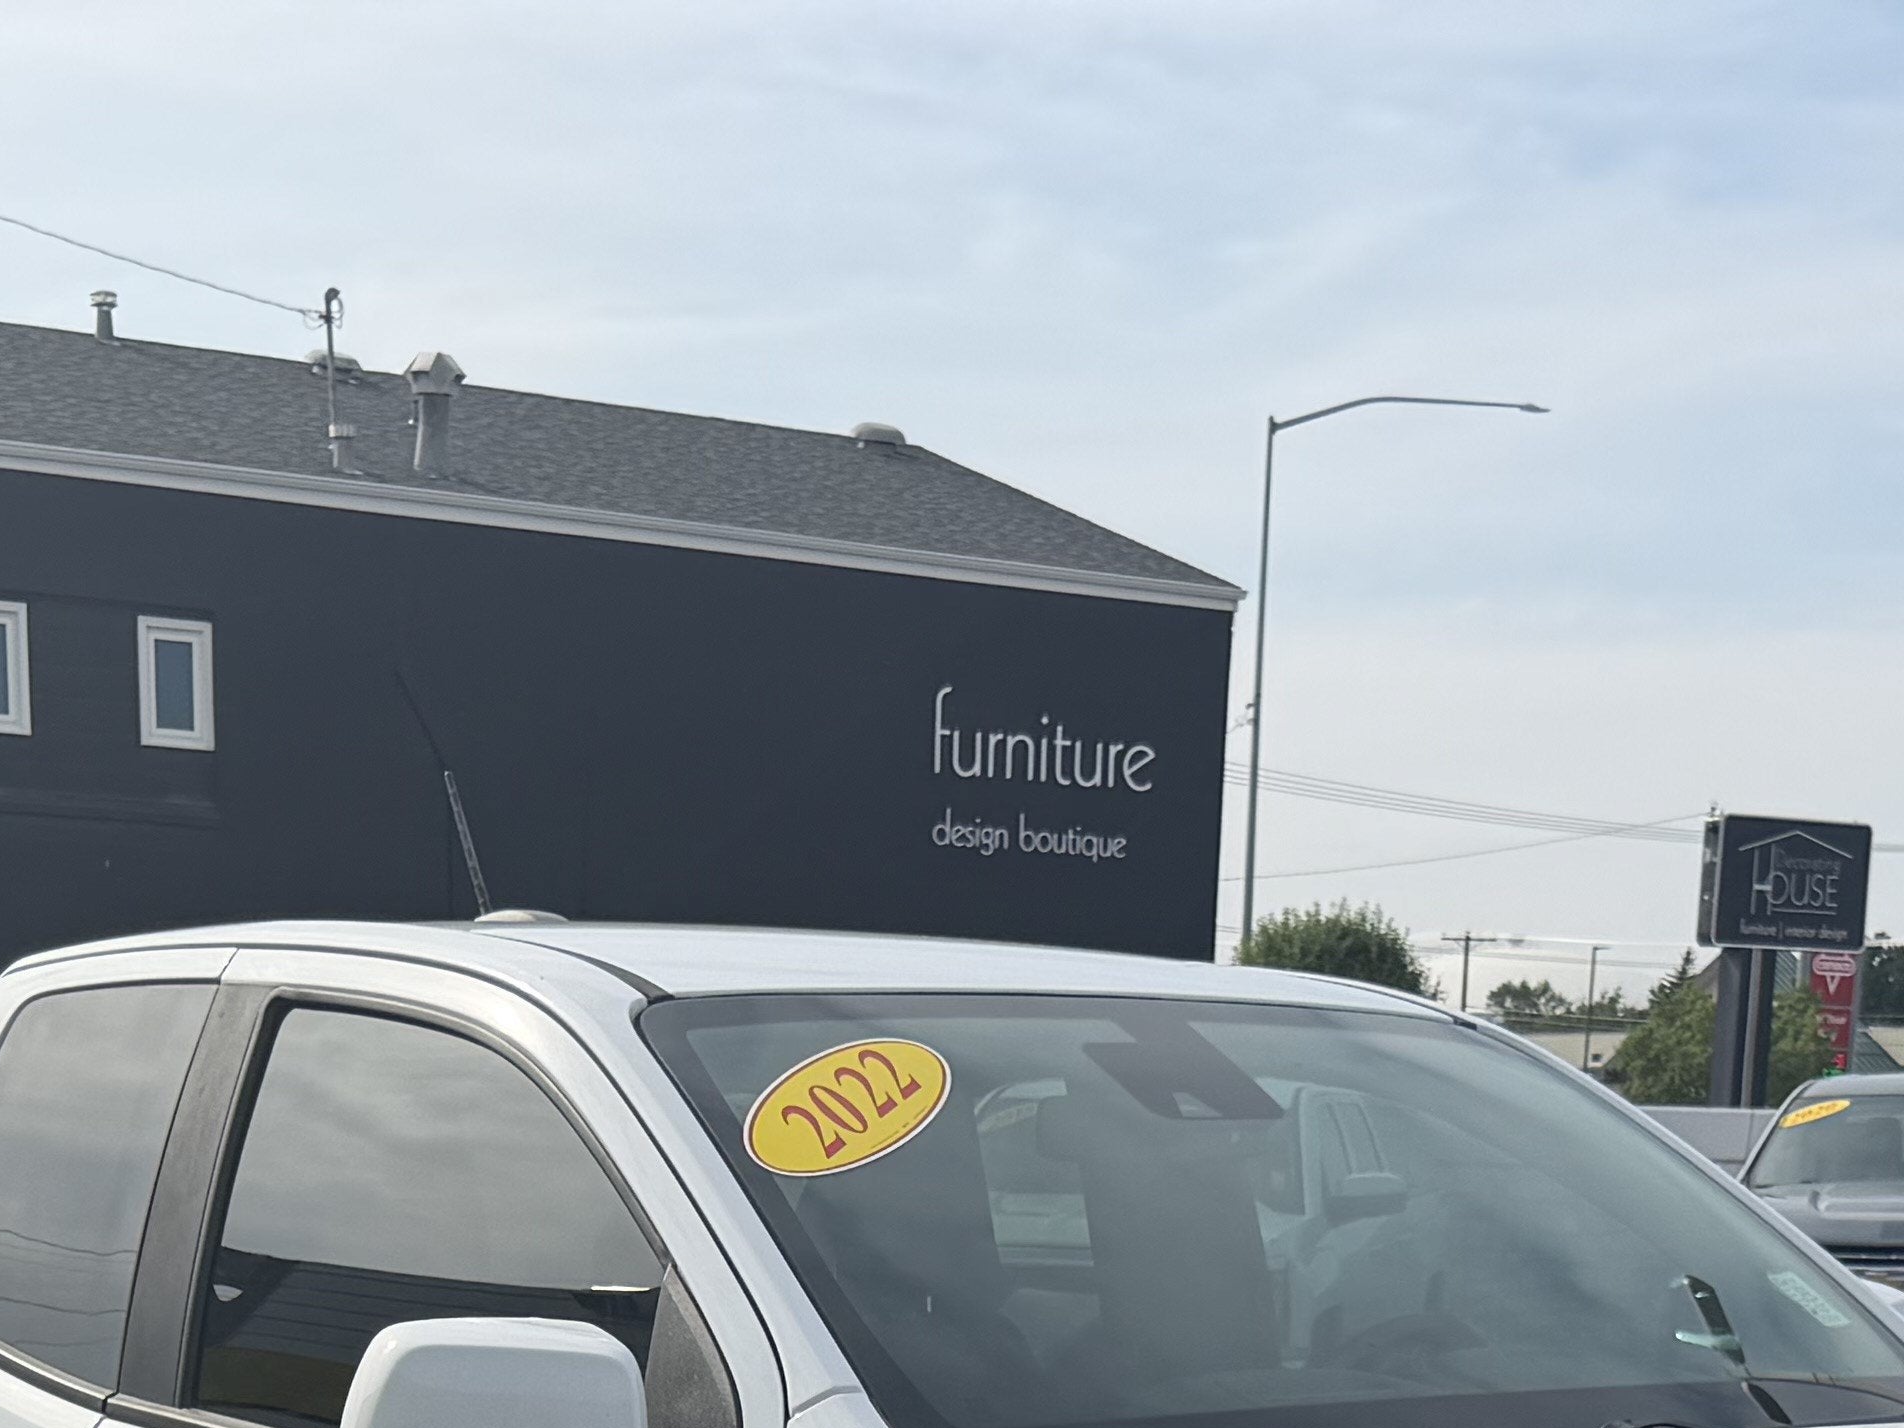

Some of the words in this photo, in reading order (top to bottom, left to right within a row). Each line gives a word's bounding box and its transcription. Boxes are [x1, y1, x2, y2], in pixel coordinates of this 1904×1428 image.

[933, 684, 1156, 793] furniture
[932, 808, 1009, 857] design
[1019, 813, 1128, 862] boutique
[1749, 844, 1840, 916] HOUSE
[781, 1049, 922, 1160] 2022
